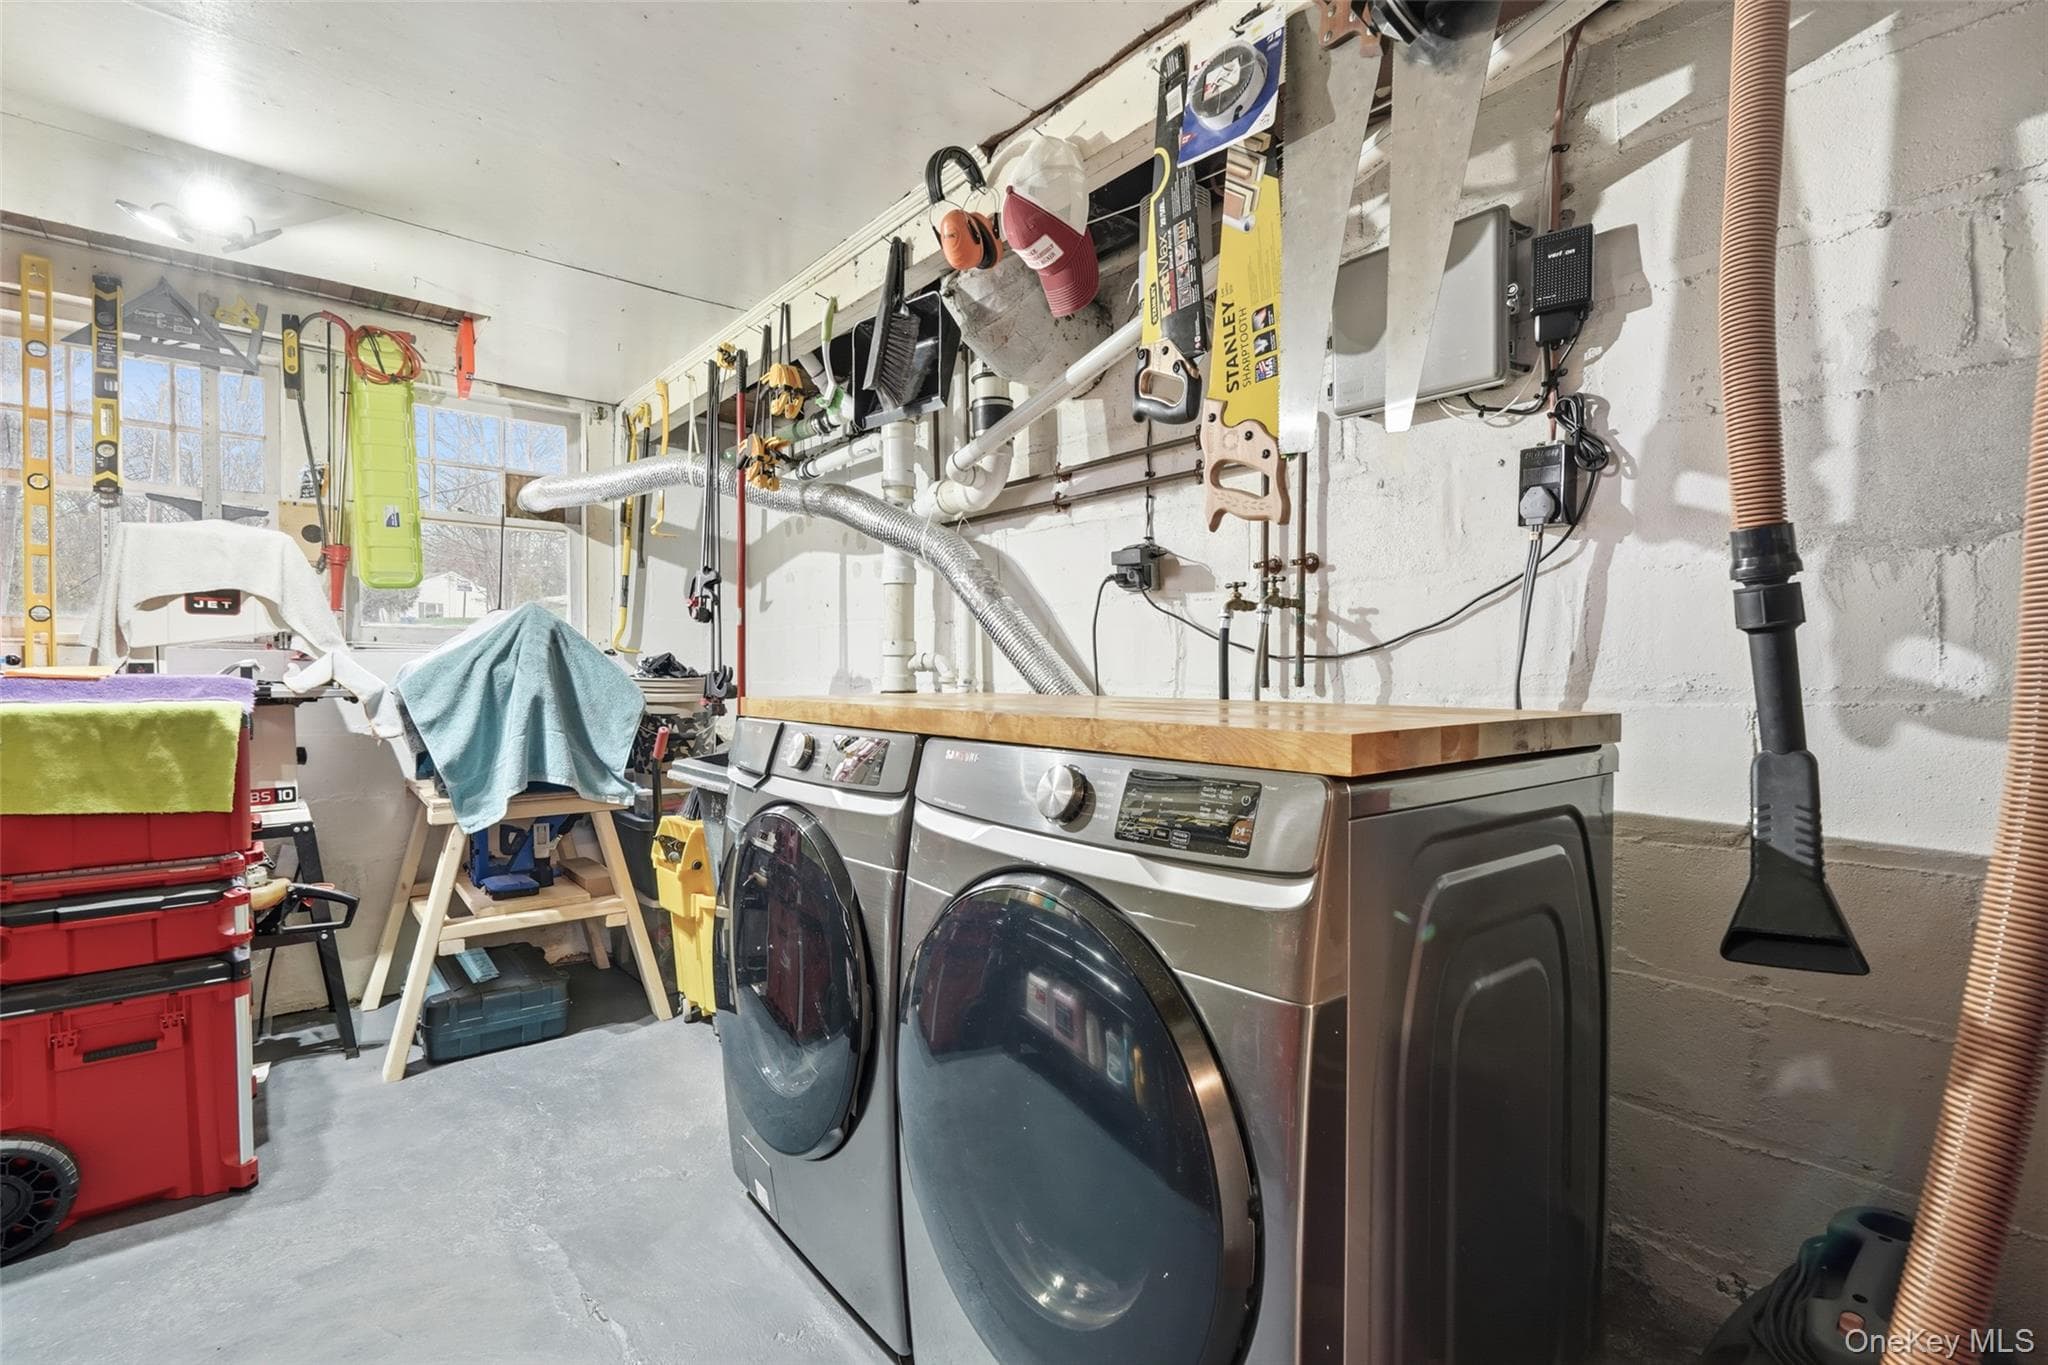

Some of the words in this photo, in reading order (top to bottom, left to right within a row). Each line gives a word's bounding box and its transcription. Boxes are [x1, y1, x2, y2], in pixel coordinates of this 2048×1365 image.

[1547, 248, 1576, 259] verion
[1150, 284, 1159, 322] STANLEY
[1221, 302, 1240, 393] STANLEY
[1239, 306, 1252, 388] SHARPTOOTH
[193, 600, 233, 609] JET
[277, 789, 294, 801] 10
